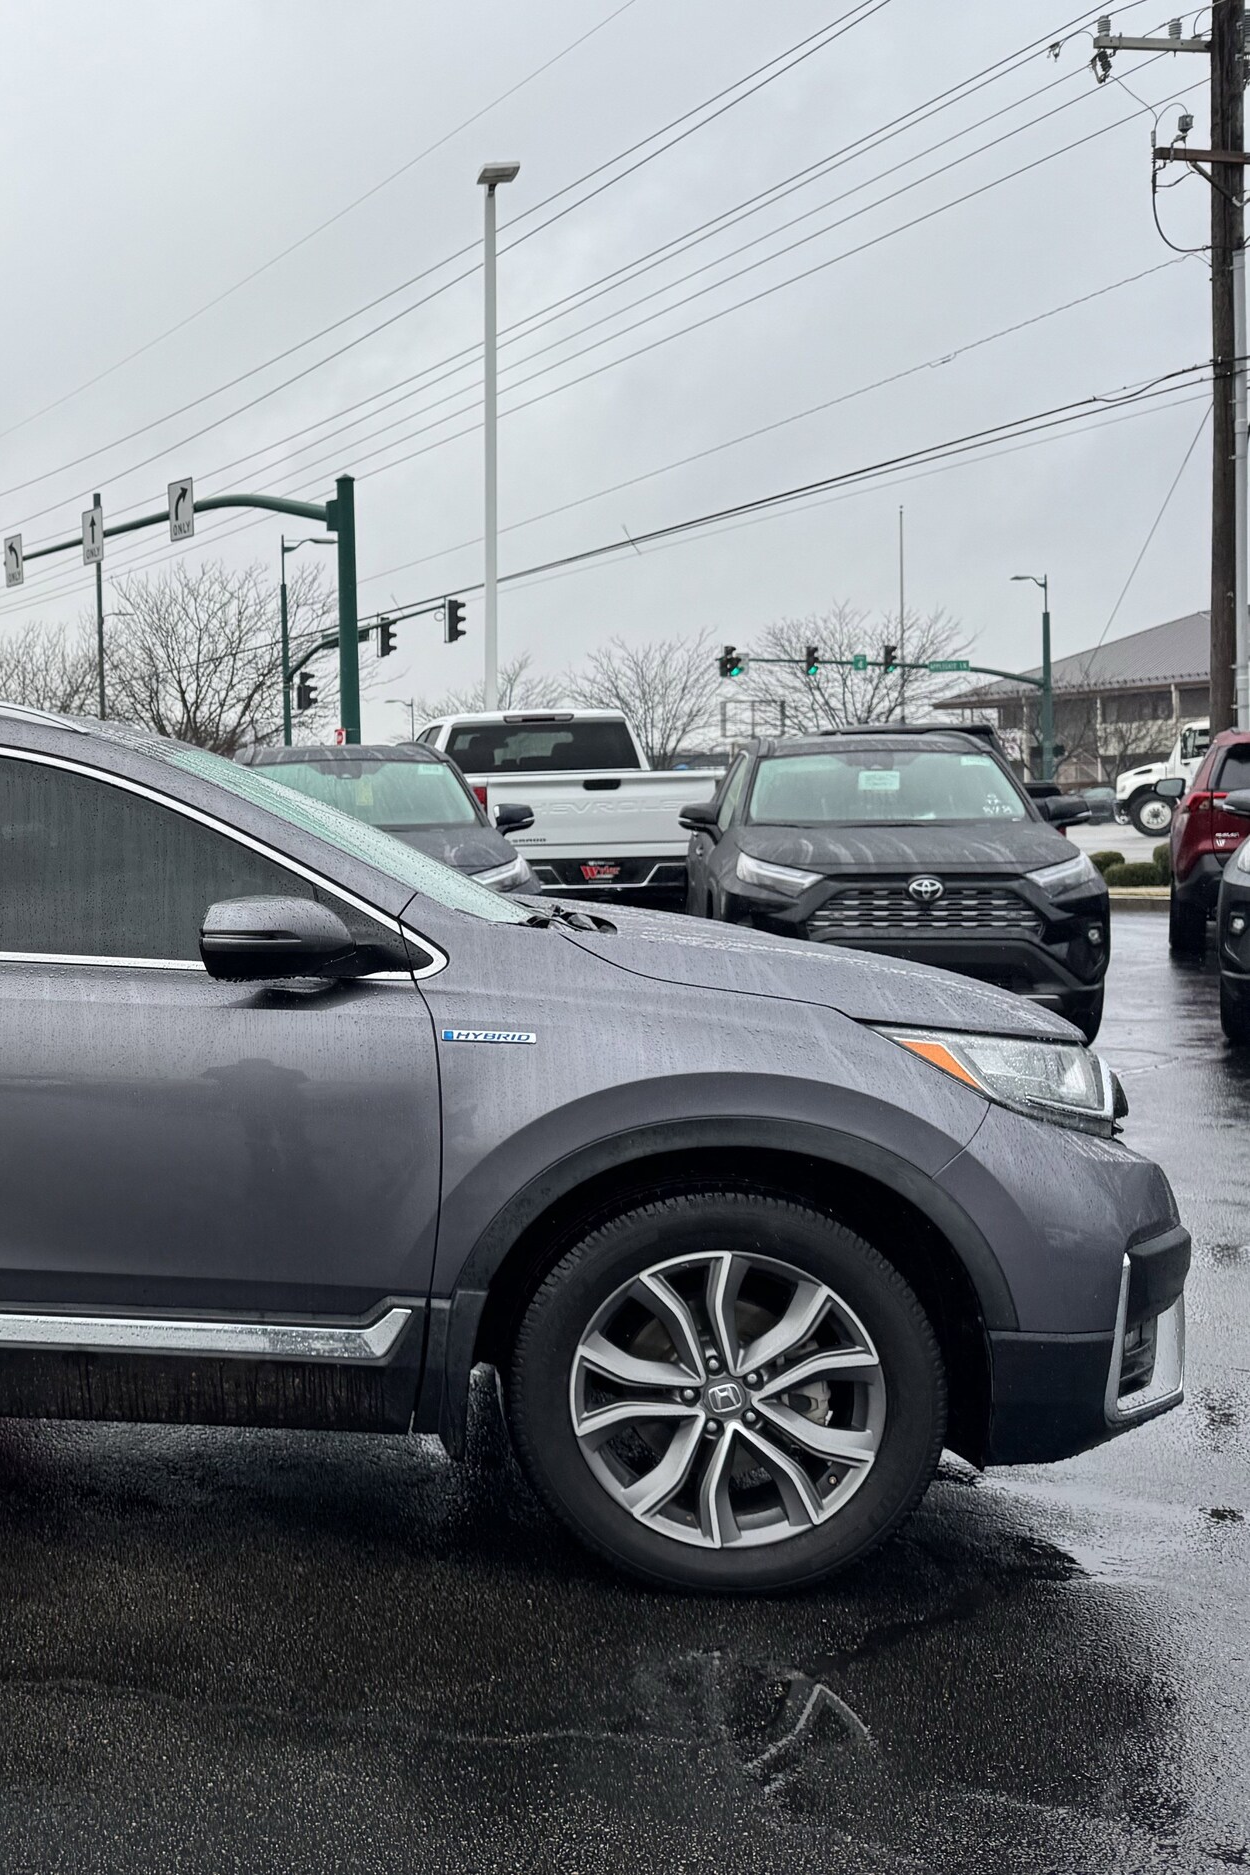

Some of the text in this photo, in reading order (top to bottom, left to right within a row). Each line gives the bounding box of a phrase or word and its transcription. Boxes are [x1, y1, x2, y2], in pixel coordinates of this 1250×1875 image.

[172, 520, 192, 537] ONLY
[85, 547, 101, 560] ONLY
[7, 571, 22, 583] ONLY
[533, 798, 699, 815] HEVROLE
[456, 1031, 530, 1042] HYBRID
